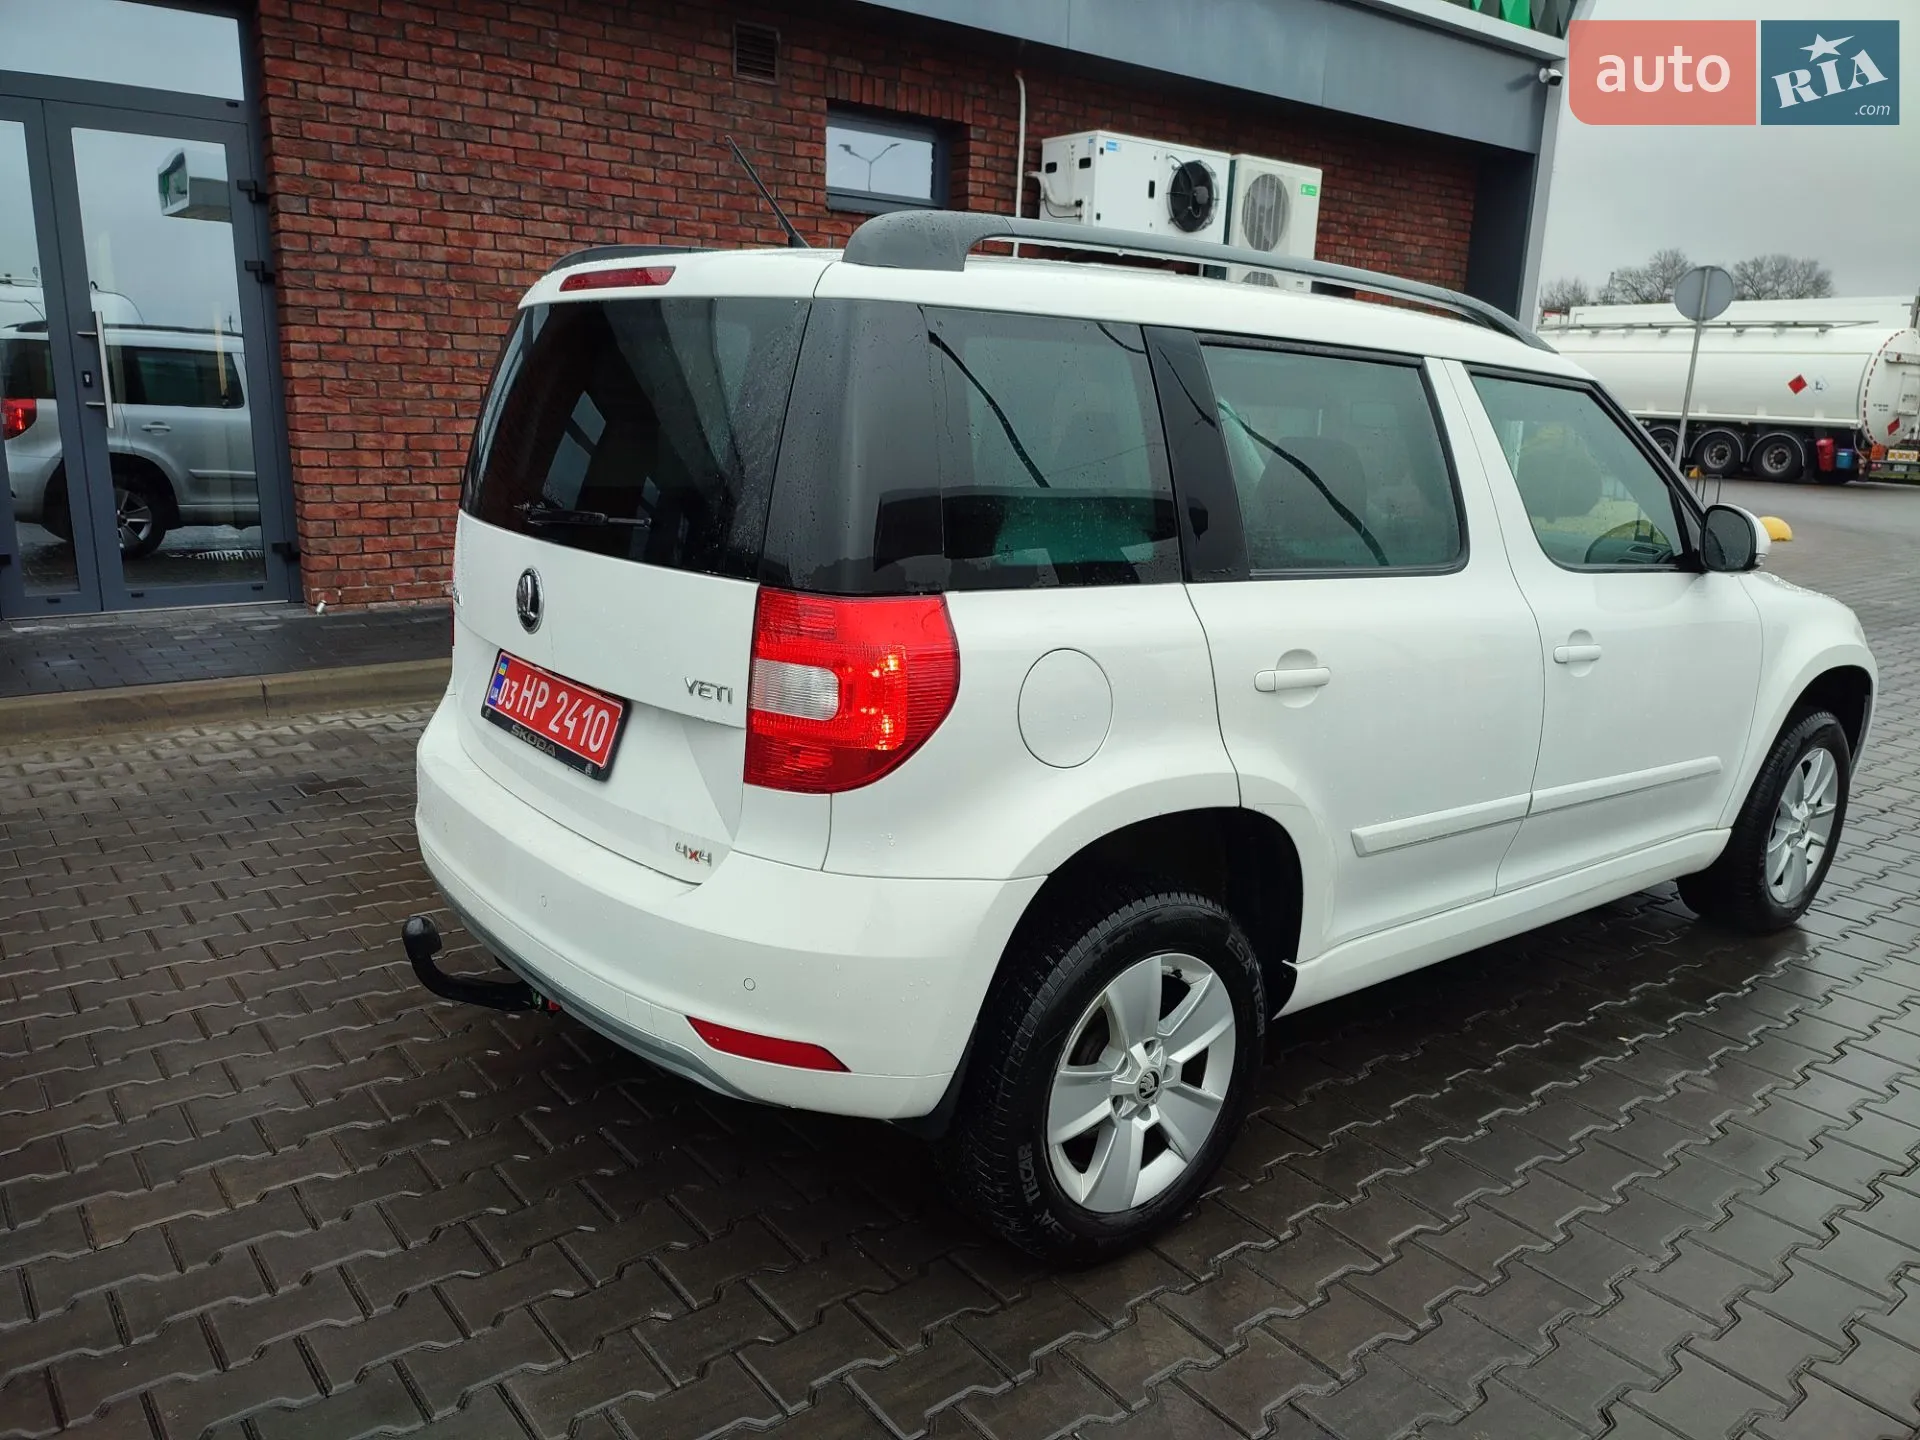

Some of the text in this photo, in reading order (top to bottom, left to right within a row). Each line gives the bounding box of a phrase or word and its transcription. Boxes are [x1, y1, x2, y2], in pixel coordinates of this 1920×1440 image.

[497, 674, 610, 753] 03 HP 2410
[684, 676, 734, 704] YETI
